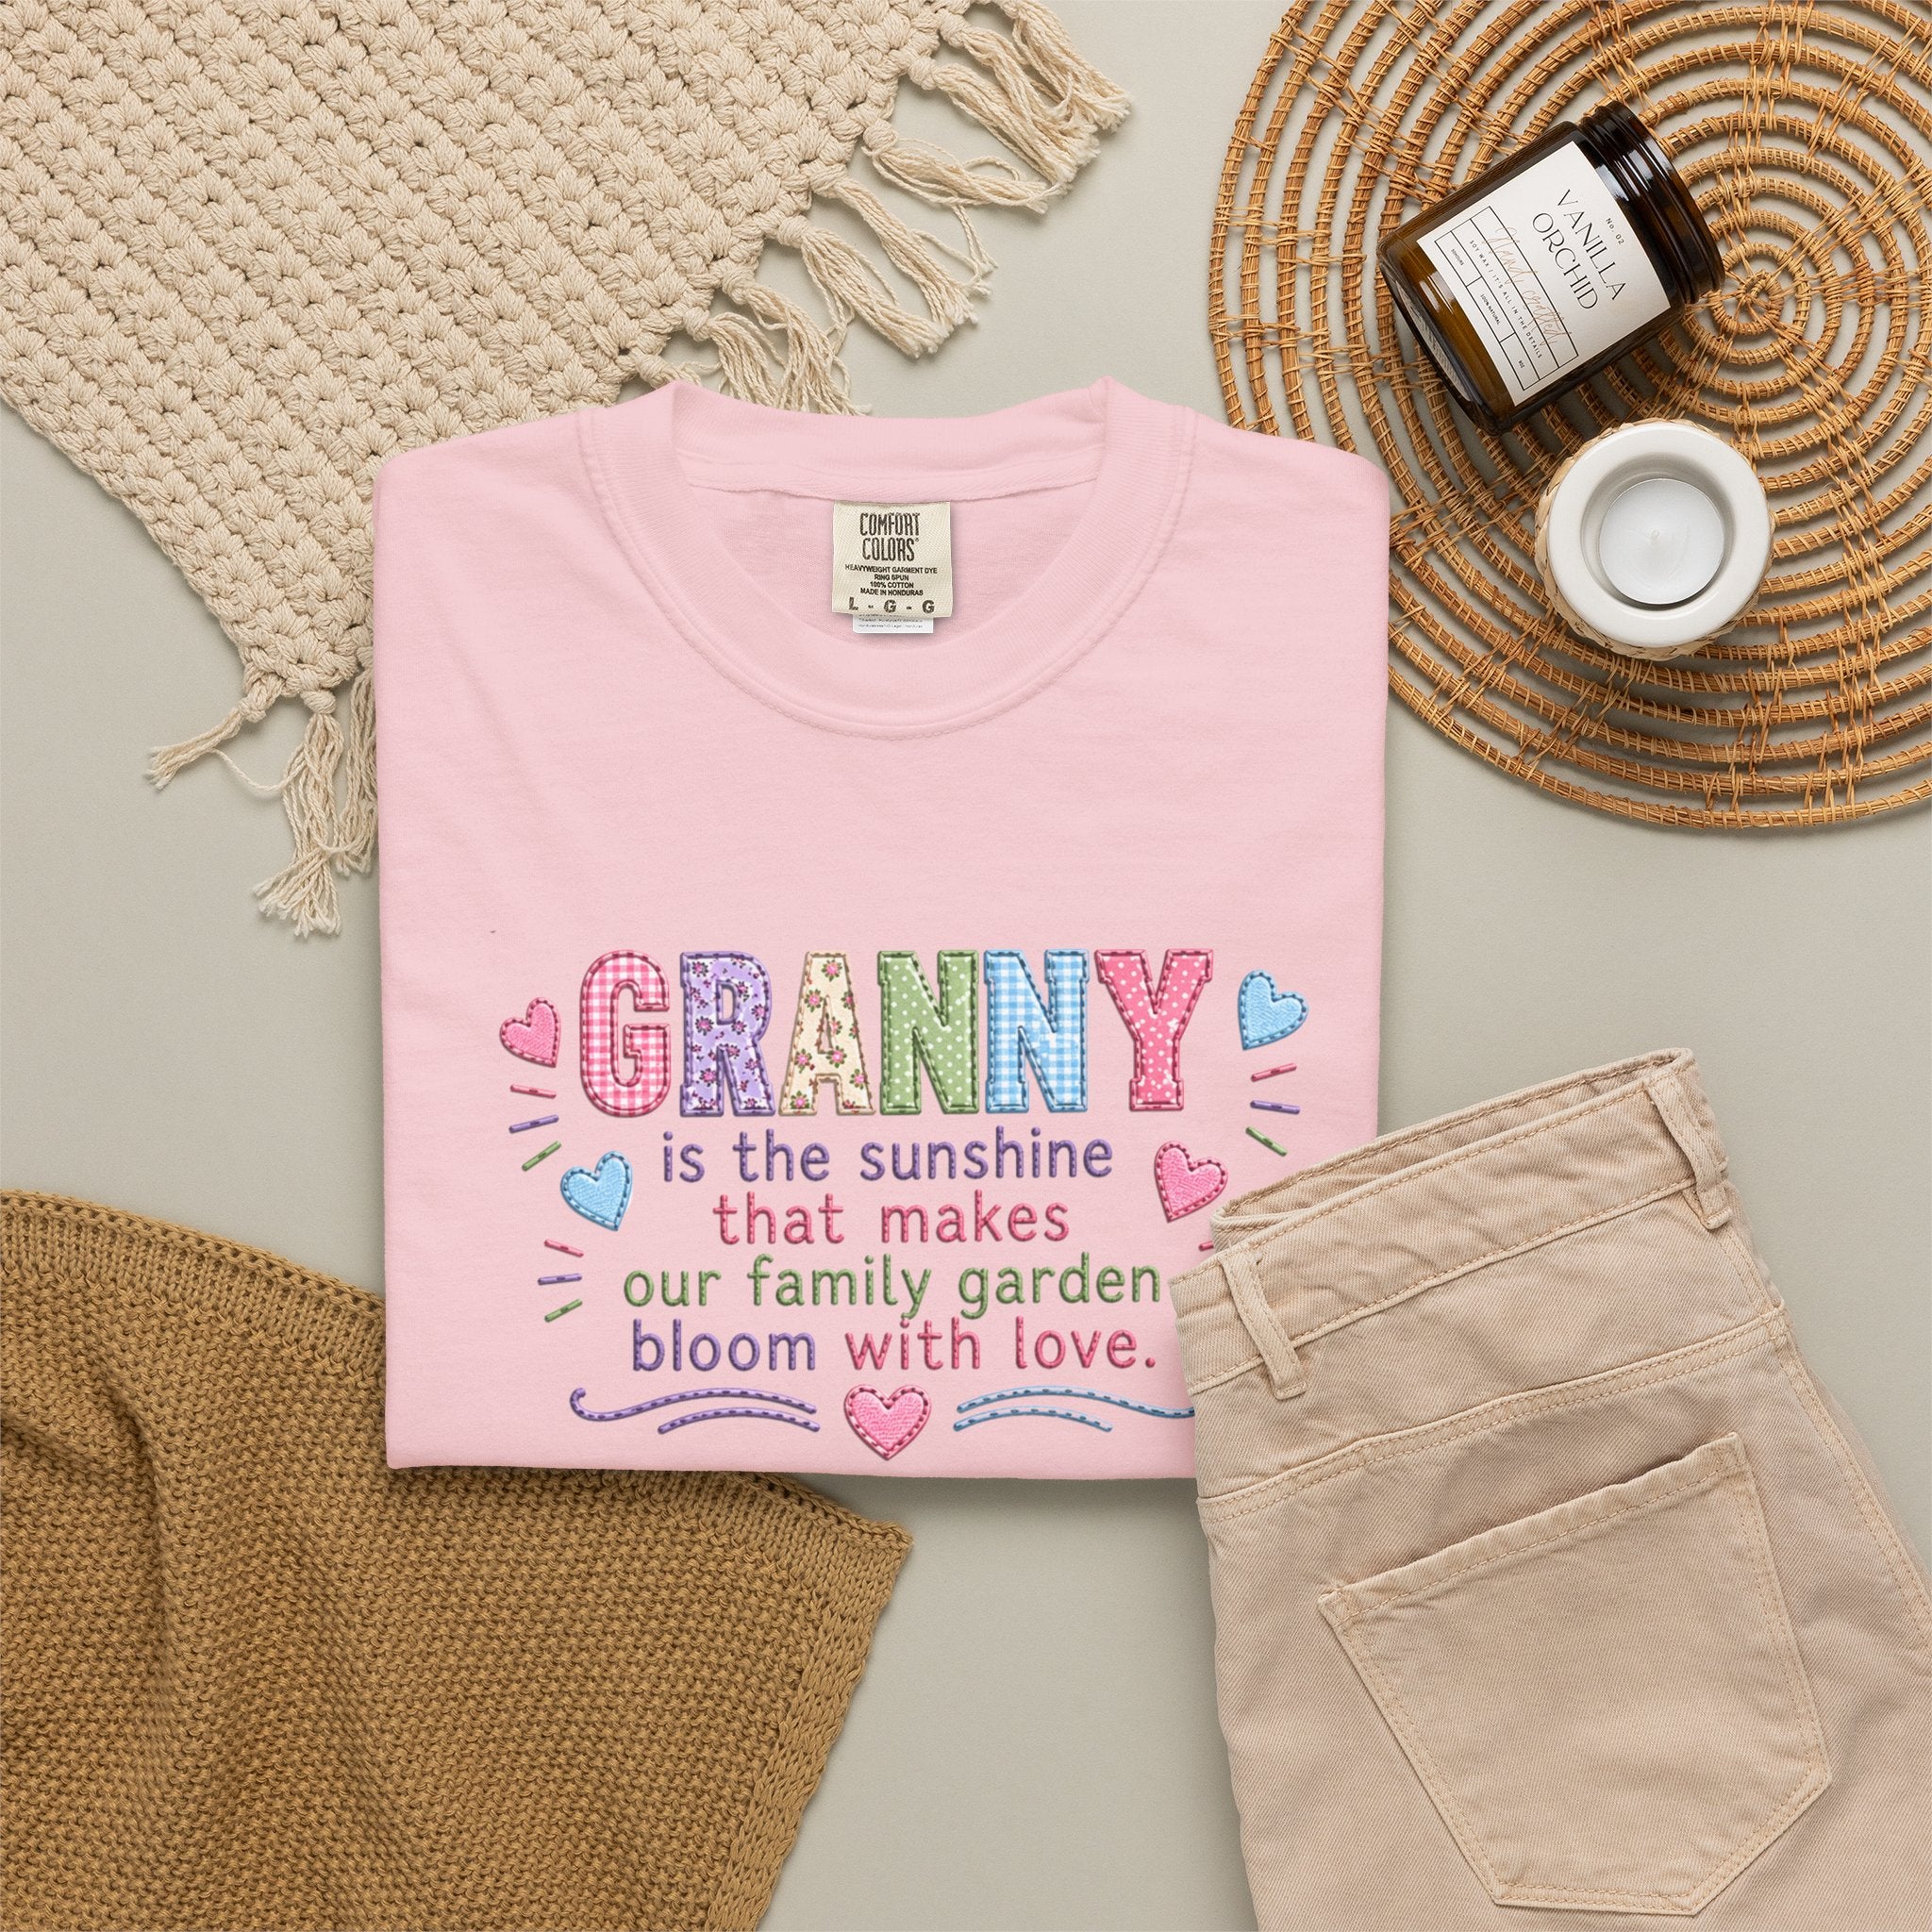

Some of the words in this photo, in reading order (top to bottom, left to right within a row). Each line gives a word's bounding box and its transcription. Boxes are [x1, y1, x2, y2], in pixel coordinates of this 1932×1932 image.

[1481, 226, 1539, 285] Hand
[1557, 189, 1626, 301] VANILLA
[1606, 218, 1616, 233] No.
[1616, 233, 1624, 245] 02
[1532, 212, 1598, 309] ORCHID
[1470, 240, 1480, 252] SOY
[1478, 254, 1490, 267] WAX
[1492, 275, 1503, 289] IT'S
[1503, 291, 1511, 304] ALL
[1511, 306, 1519, 314] IN
[1518, 316, 1527, 329] THE
[1525, 331, 1542, 358] DETAILS
[859, 512, 920, 536] COMFORT
[845, 564, 891, 574] HEAVYWEIGHT
[849, 596, 859, 610] L
[884, 599, 897, 613] G
[922, 599, 935, 613] G
[578, 948, 1215, 1118] GRANNY
[663, 1130, 705, 1182] is
[732, 1128, 830, 1181] the
[859, 1126, 1113, 1181] sunshine
[713, 1191, 845, 1244] that
[881, 1190, 1070, 1243] makes
[623, 1268, 723, 1307] our
[747, 1253, 932, 1320] family
[958, 1252, 1162, 1320] garden
[632, 1318, 817, 1373] bloom
[845, 1316, 981, 1372] with
[1015, 1316, 1156, 1371] love.
